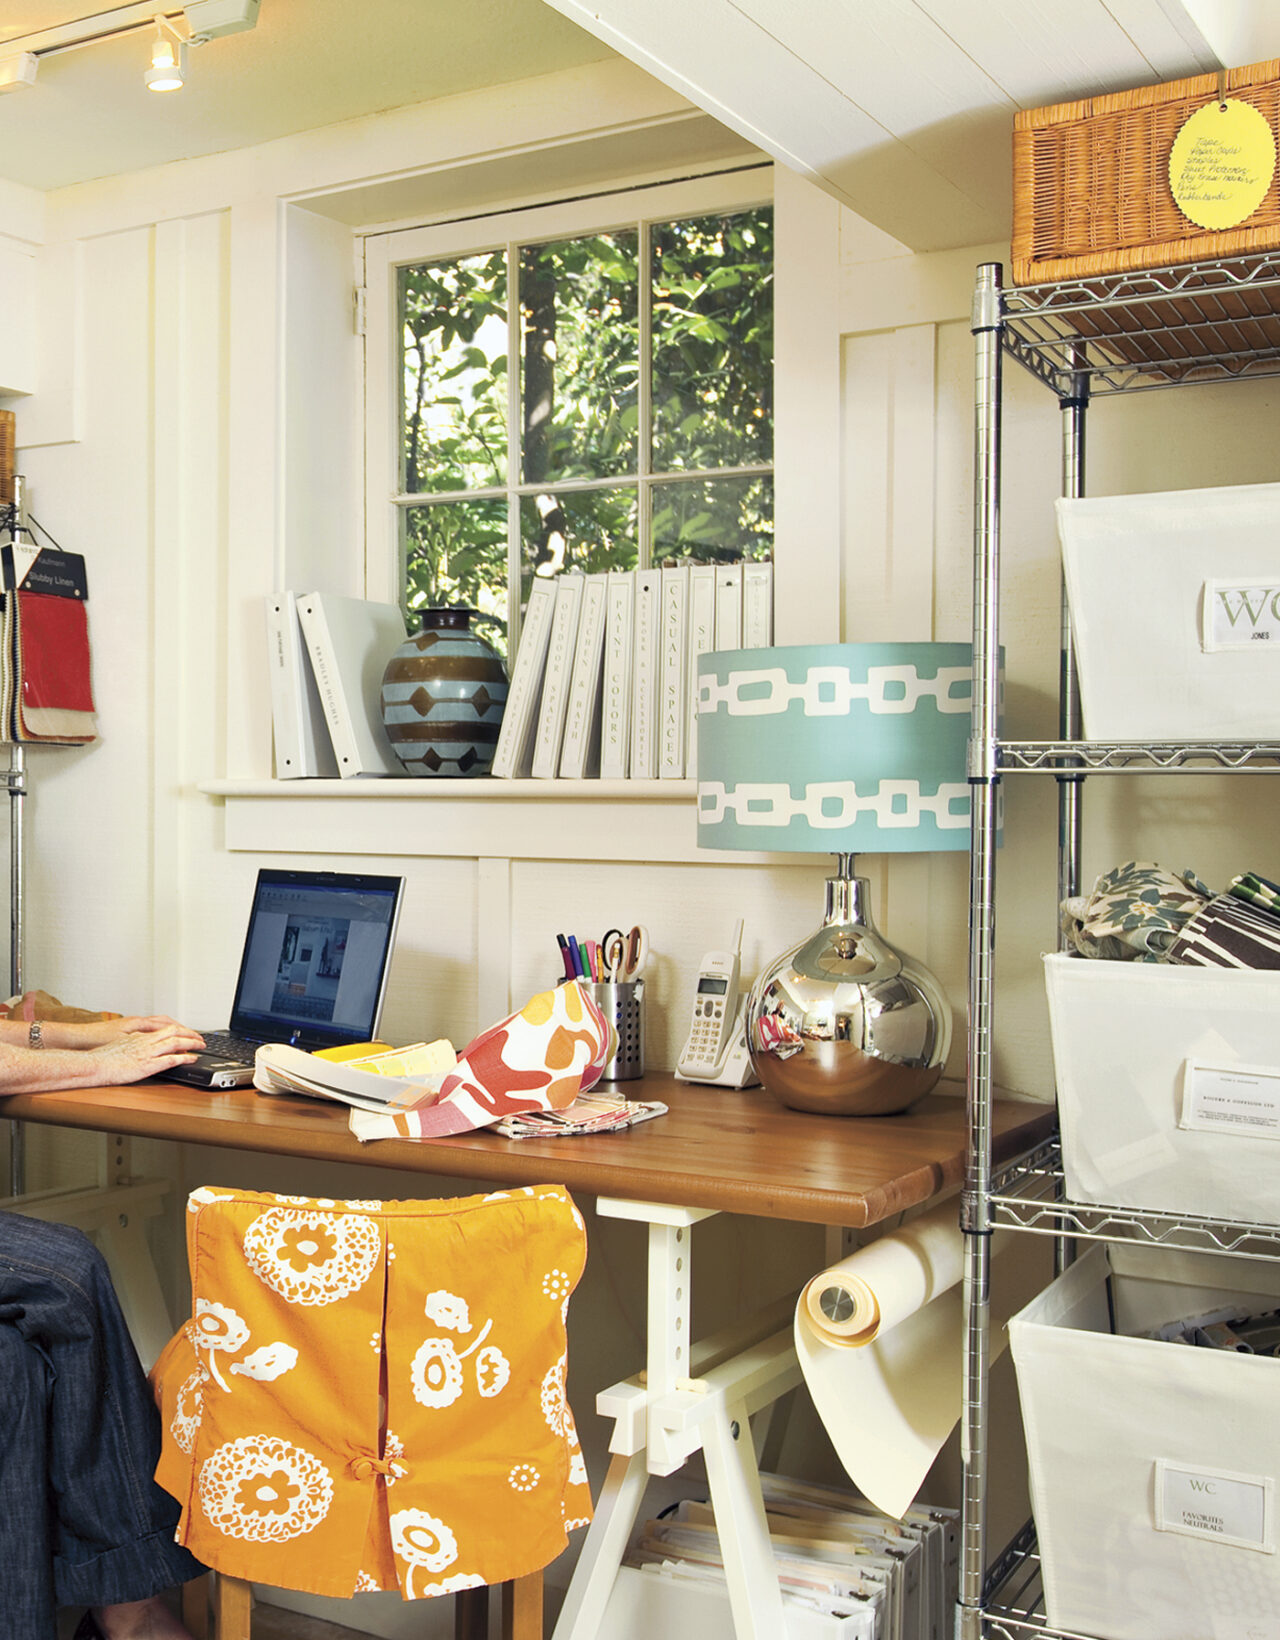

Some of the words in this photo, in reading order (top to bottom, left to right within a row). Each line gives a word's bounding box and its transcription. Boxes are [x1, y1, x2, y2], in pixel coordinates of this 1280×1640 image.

[54, 576, 74, 587] Linen
[669, 585, 679, 667] CASUAL
[1216, 589, 1280, 627] W
[553, 603, 569, 672] OUTDOOR
[614, 600, 622, 658] PAINT
[1251, 631, 1270, 640] JONES
[571, 700, 582, 740] BATH
[610, 674, 620, 744] COLORS
[666, 685, 676, 766] SPACES
[1189, 1479, 1217, 1495] WC
[1182, 1511, 1224, 1525] FAVORITES
[1183, 1518, 1224, 1532] NEUTRALS
